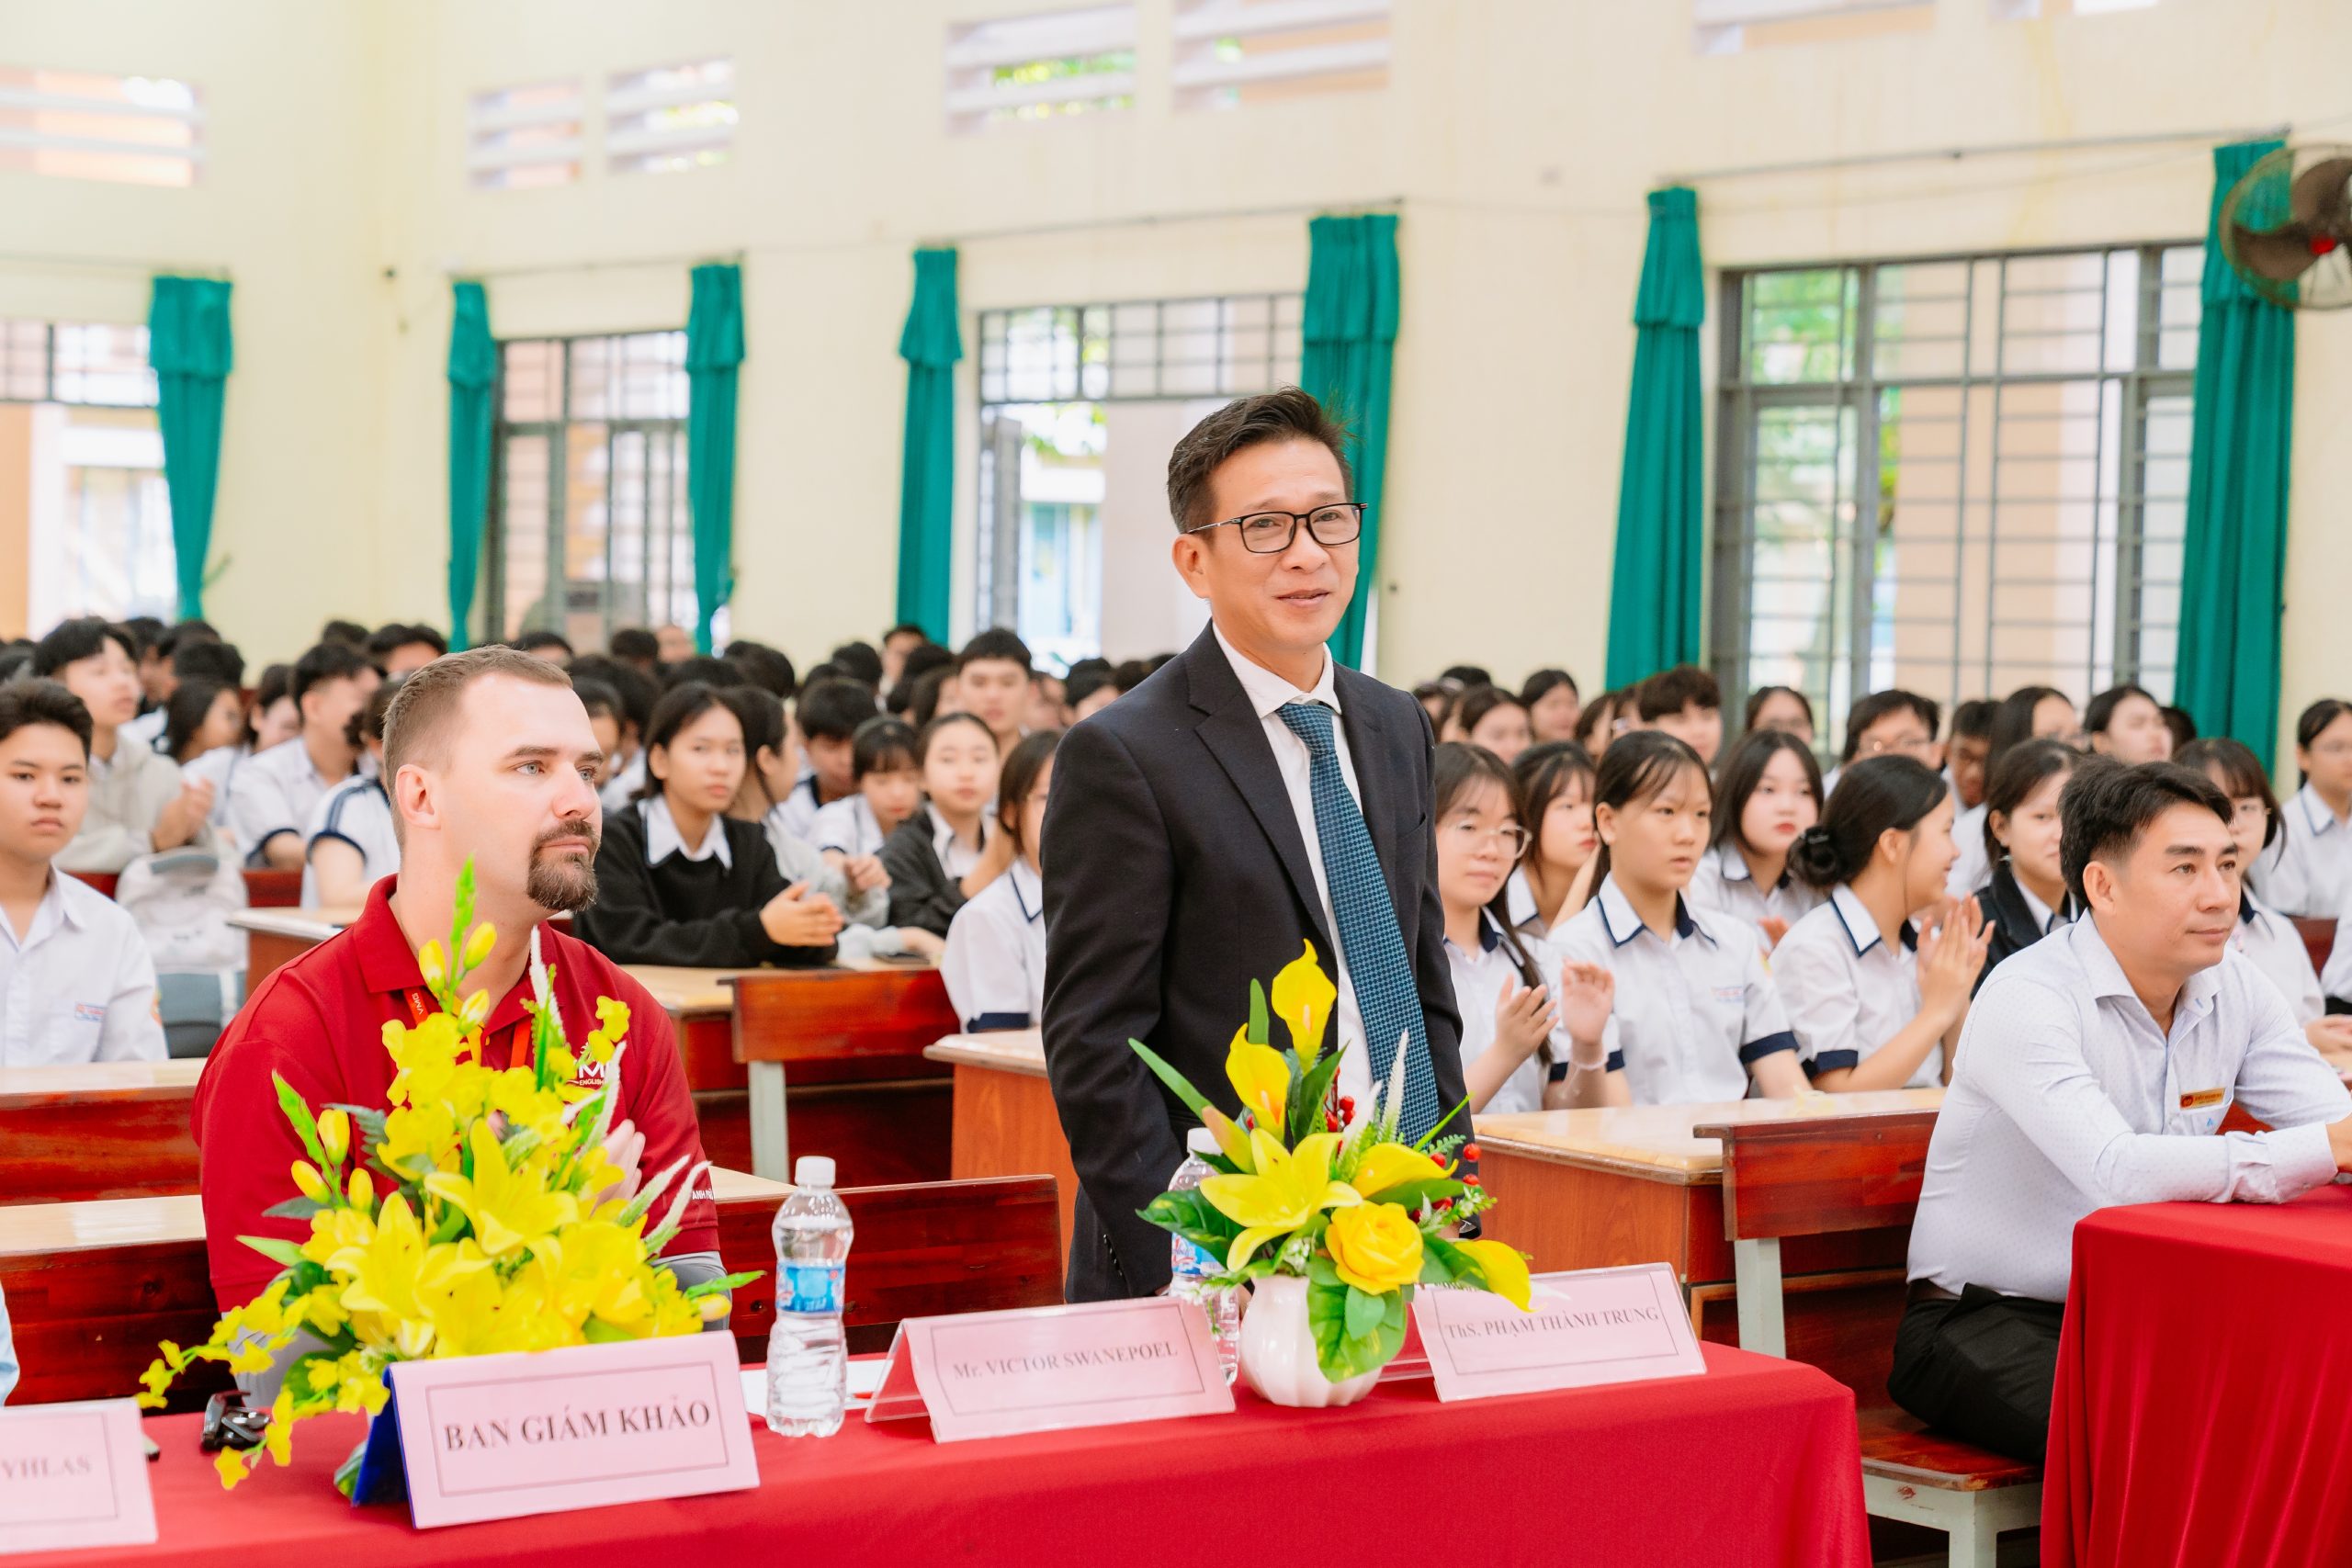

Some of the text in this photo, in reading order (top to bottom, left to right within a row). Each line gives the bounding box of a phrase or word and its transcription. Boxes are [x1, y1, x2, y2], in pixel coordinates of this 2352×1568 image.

[1444, 1323, 1481, 1339] ThS.
[1484, 1317, 1536, 1337] PHẠM
[1599, 1306, 1660, 1325] TRUNG
[953, 1340, 1179, 1379] Mr. VICTOR SWANEPOEL
[445, 1393, 710, 1452] BAN GIÁM KHẢO
